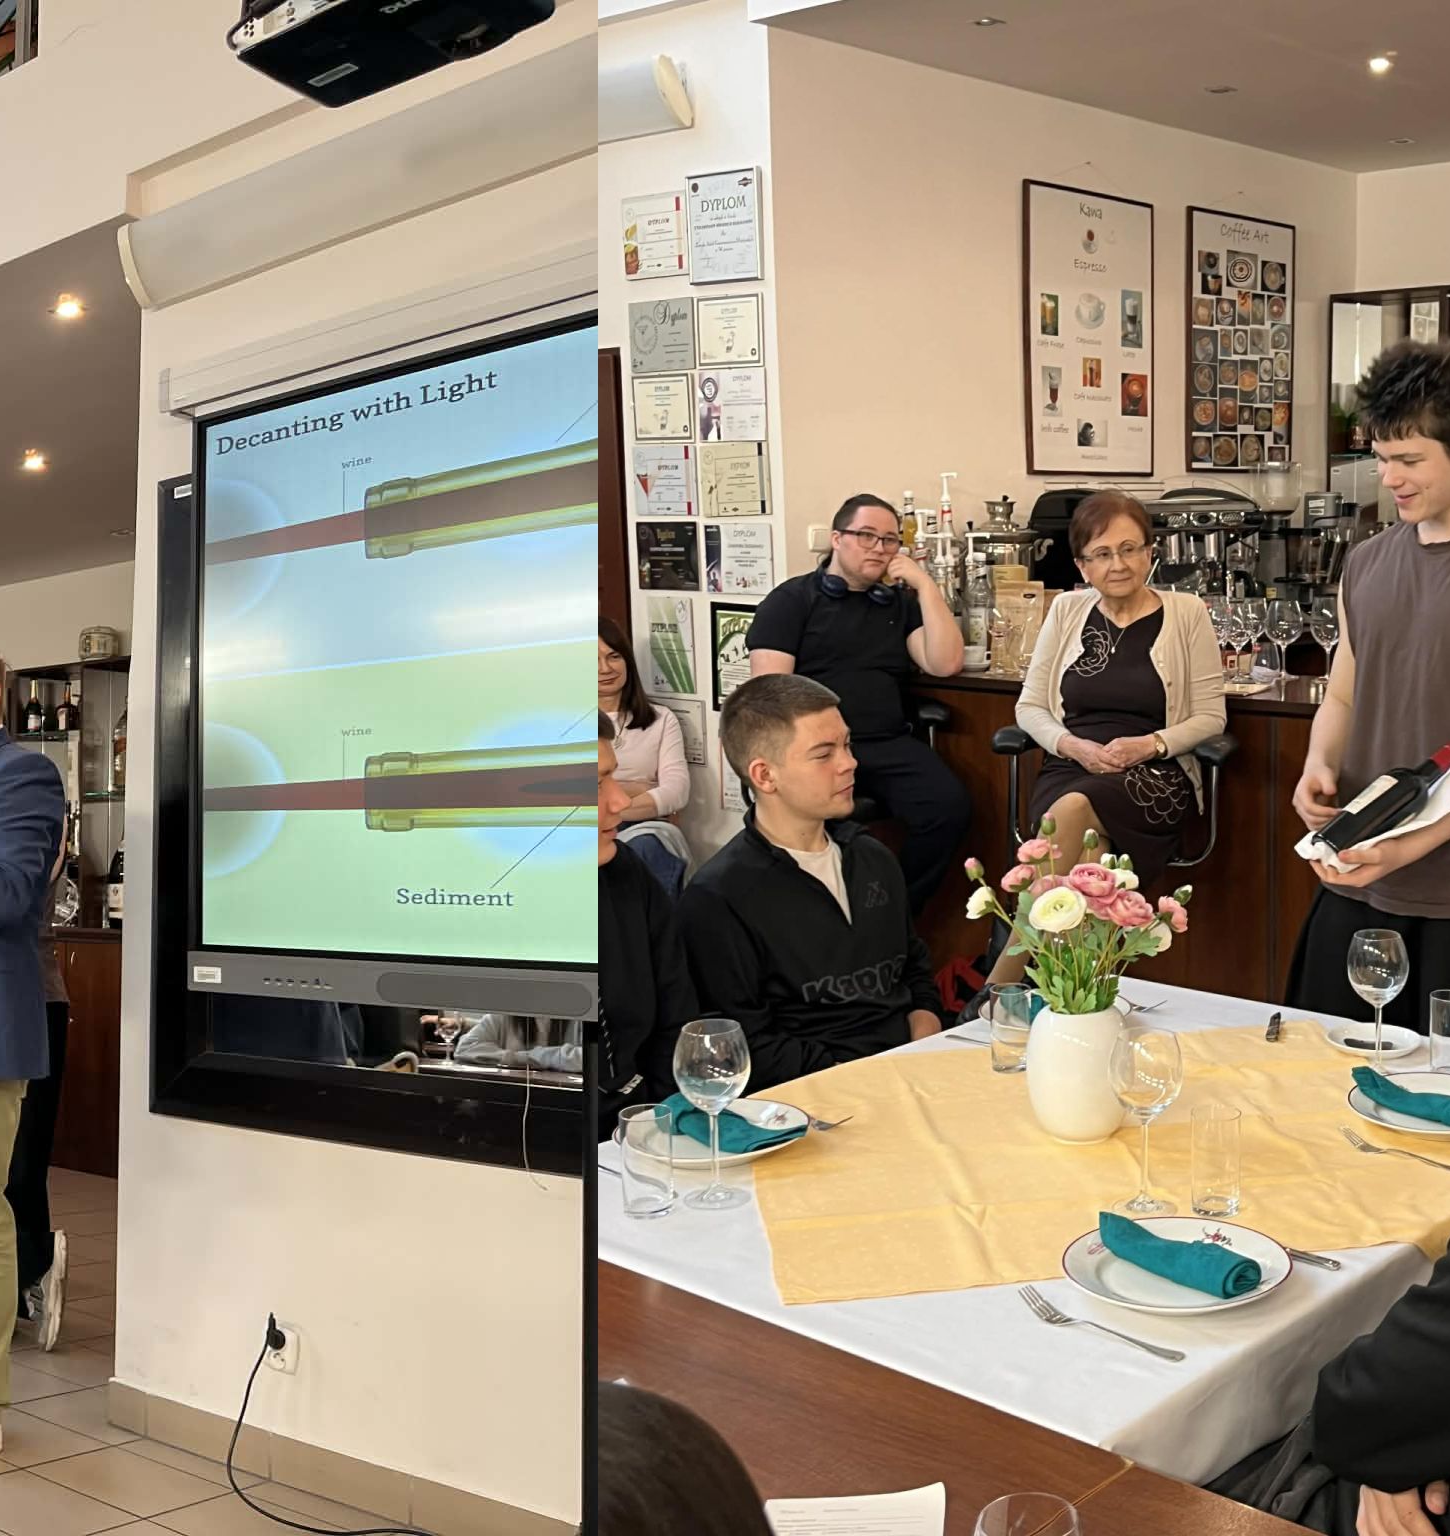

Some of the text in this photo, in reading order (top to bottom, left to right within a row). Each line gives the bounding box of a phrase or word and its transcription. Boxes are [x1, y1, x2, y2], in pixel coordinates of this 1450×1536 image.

[701, 195, 747, 213] DYPLOM
[1079, 202, 1103, 220] Kawa
[1220, 222, 1270, 245] Coffee Art
[216, 370, 498, 455] Decanting with Light
[341, 457, 373, 470] wine
[341, 727, 372, 737] wine
[396, 887, 515, 907] Sediment
